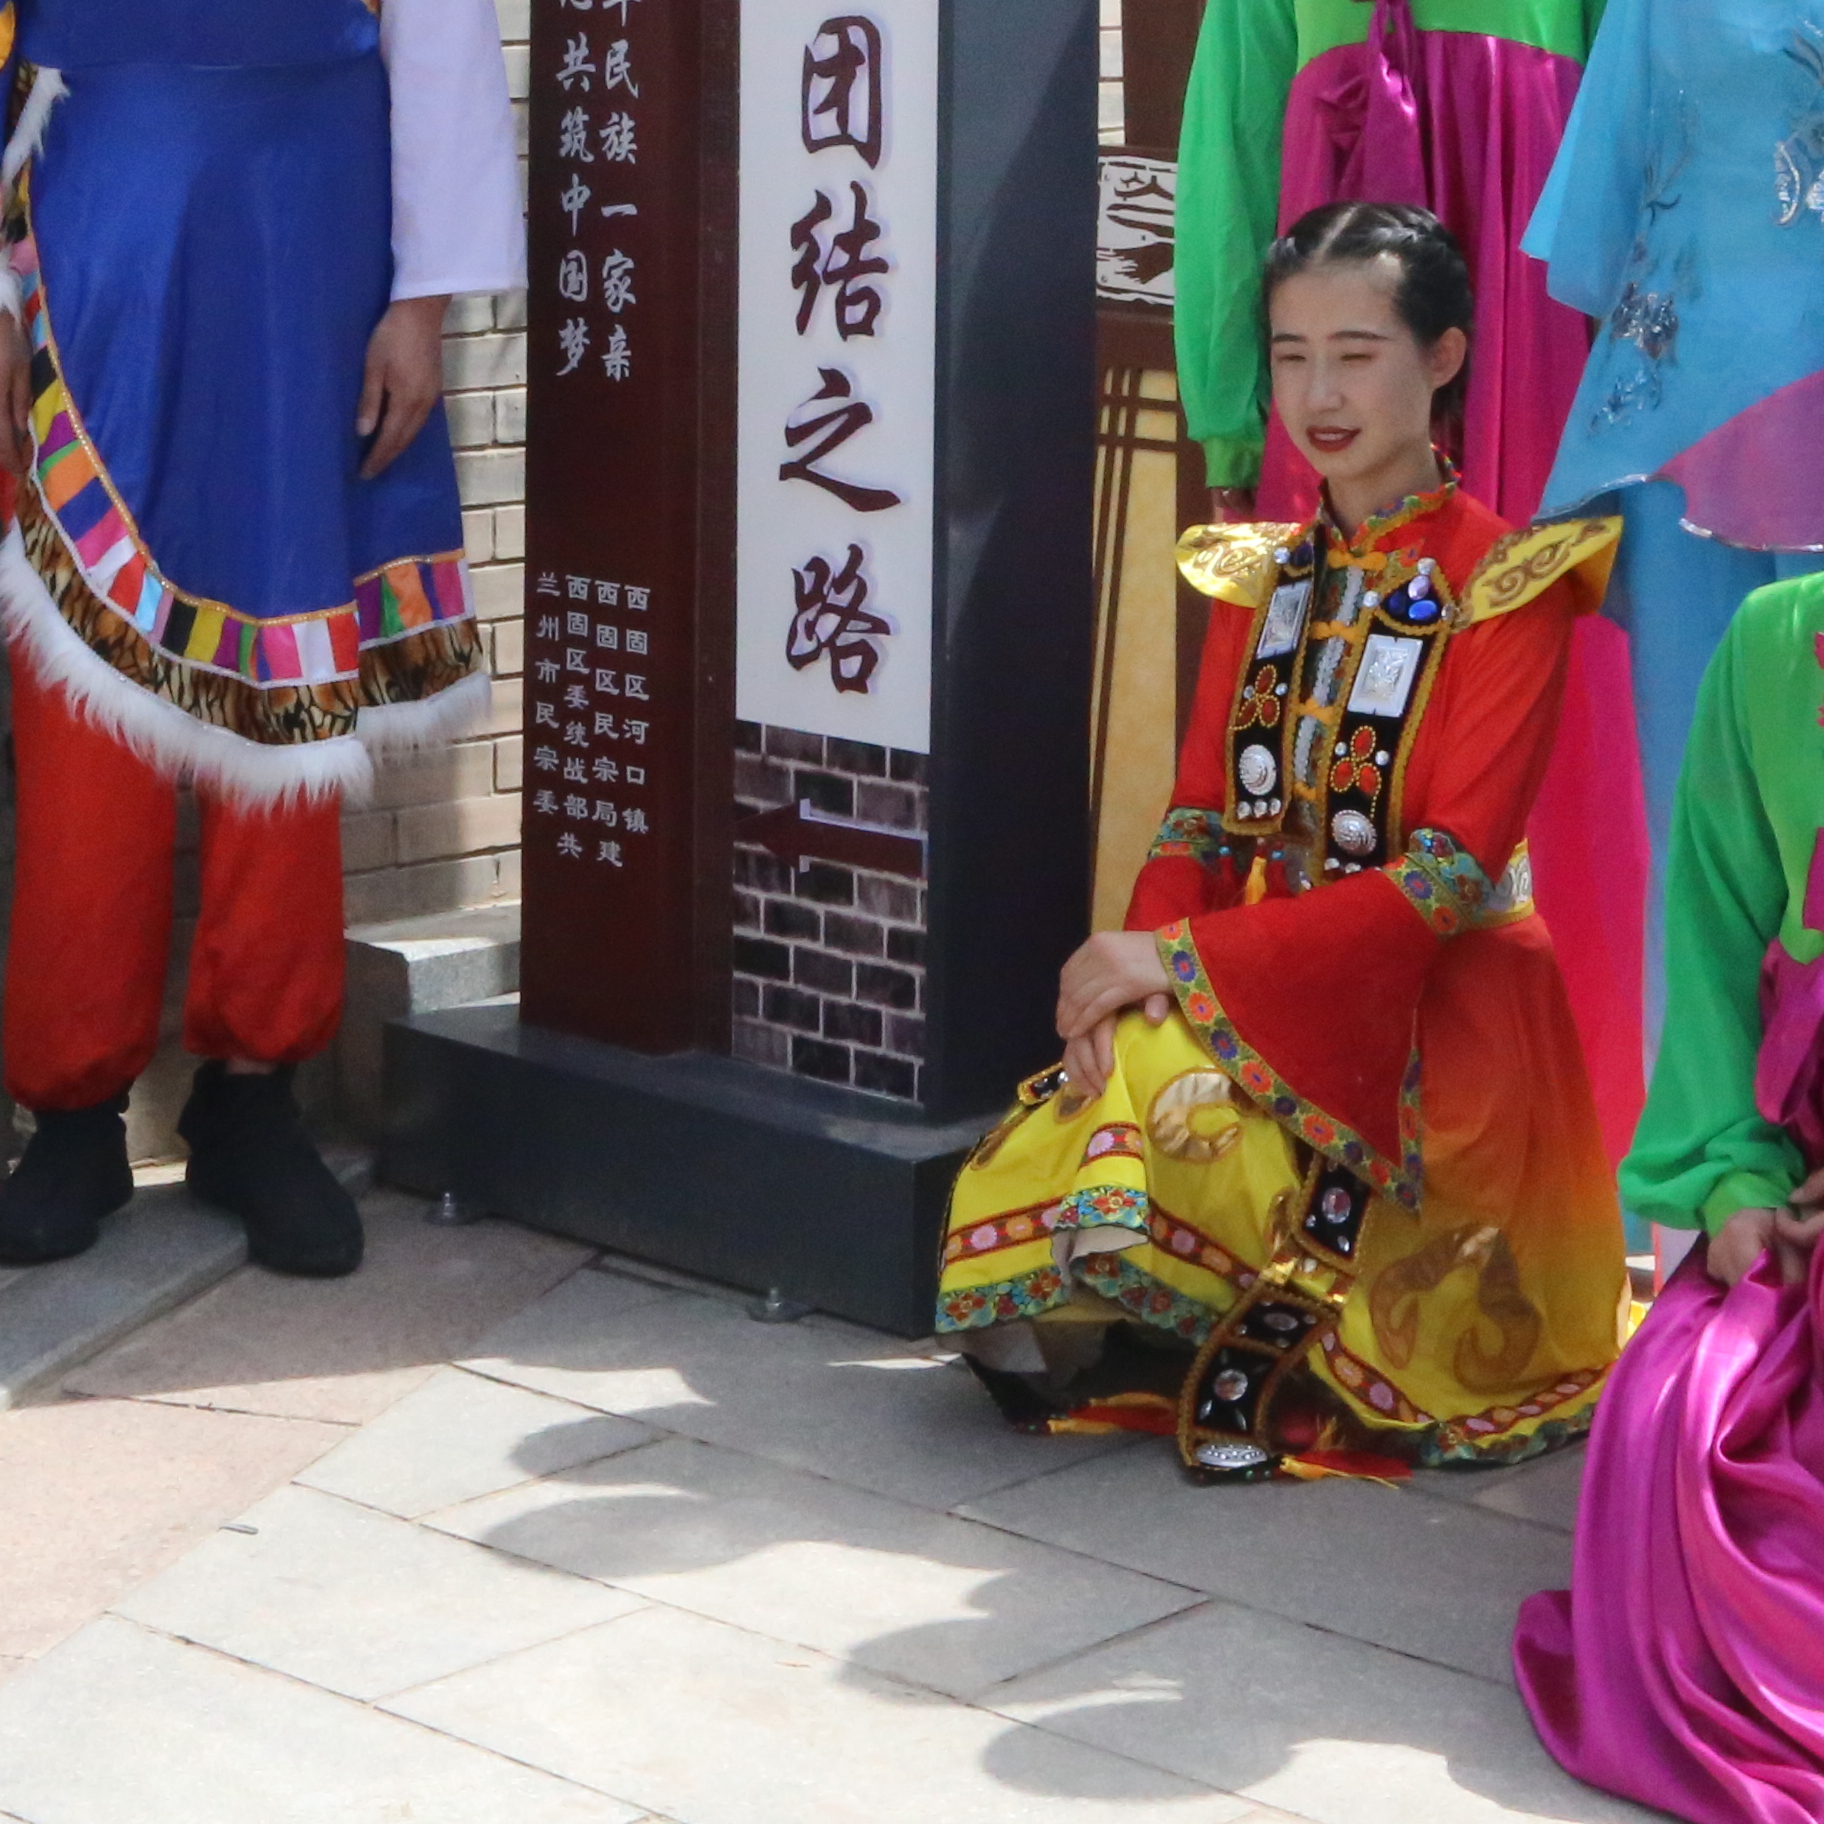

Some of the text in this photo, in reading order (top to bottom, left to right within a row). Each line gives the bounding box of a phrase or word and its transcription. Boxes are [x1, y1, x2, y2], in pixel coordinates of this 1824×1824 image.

[533, 572, 561, 814] 兰州市民宗委
[622, 584, 651, 835] 西固区河口镇
